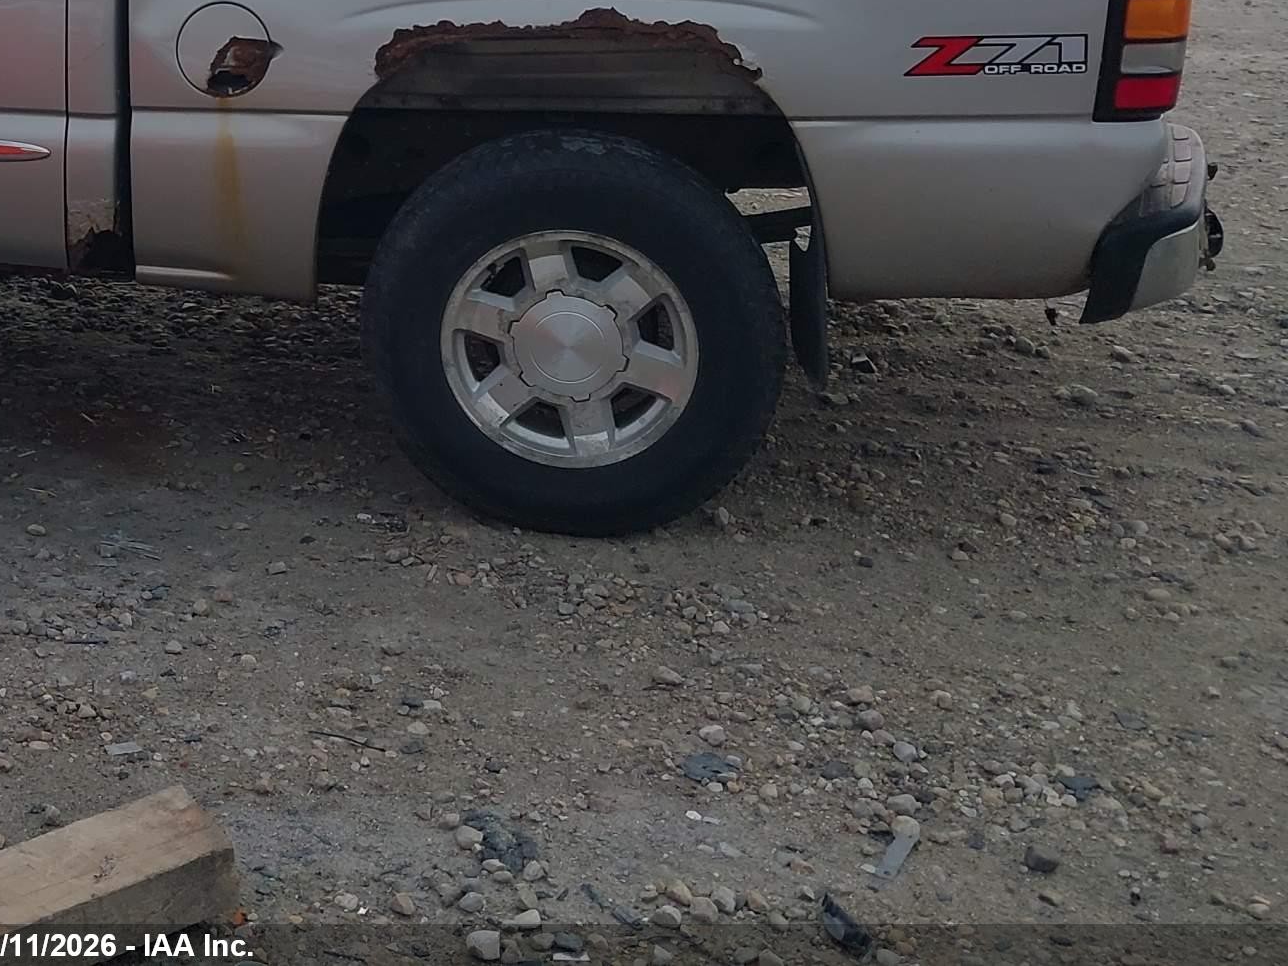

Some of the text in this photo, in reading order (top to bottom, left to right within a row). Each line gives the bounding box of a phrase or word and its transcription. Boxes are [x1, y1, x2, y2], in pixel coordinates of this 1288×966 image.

[903, 34, 1089, 76] Z71
[984, 63, 1087, 75] OFF ROAD
